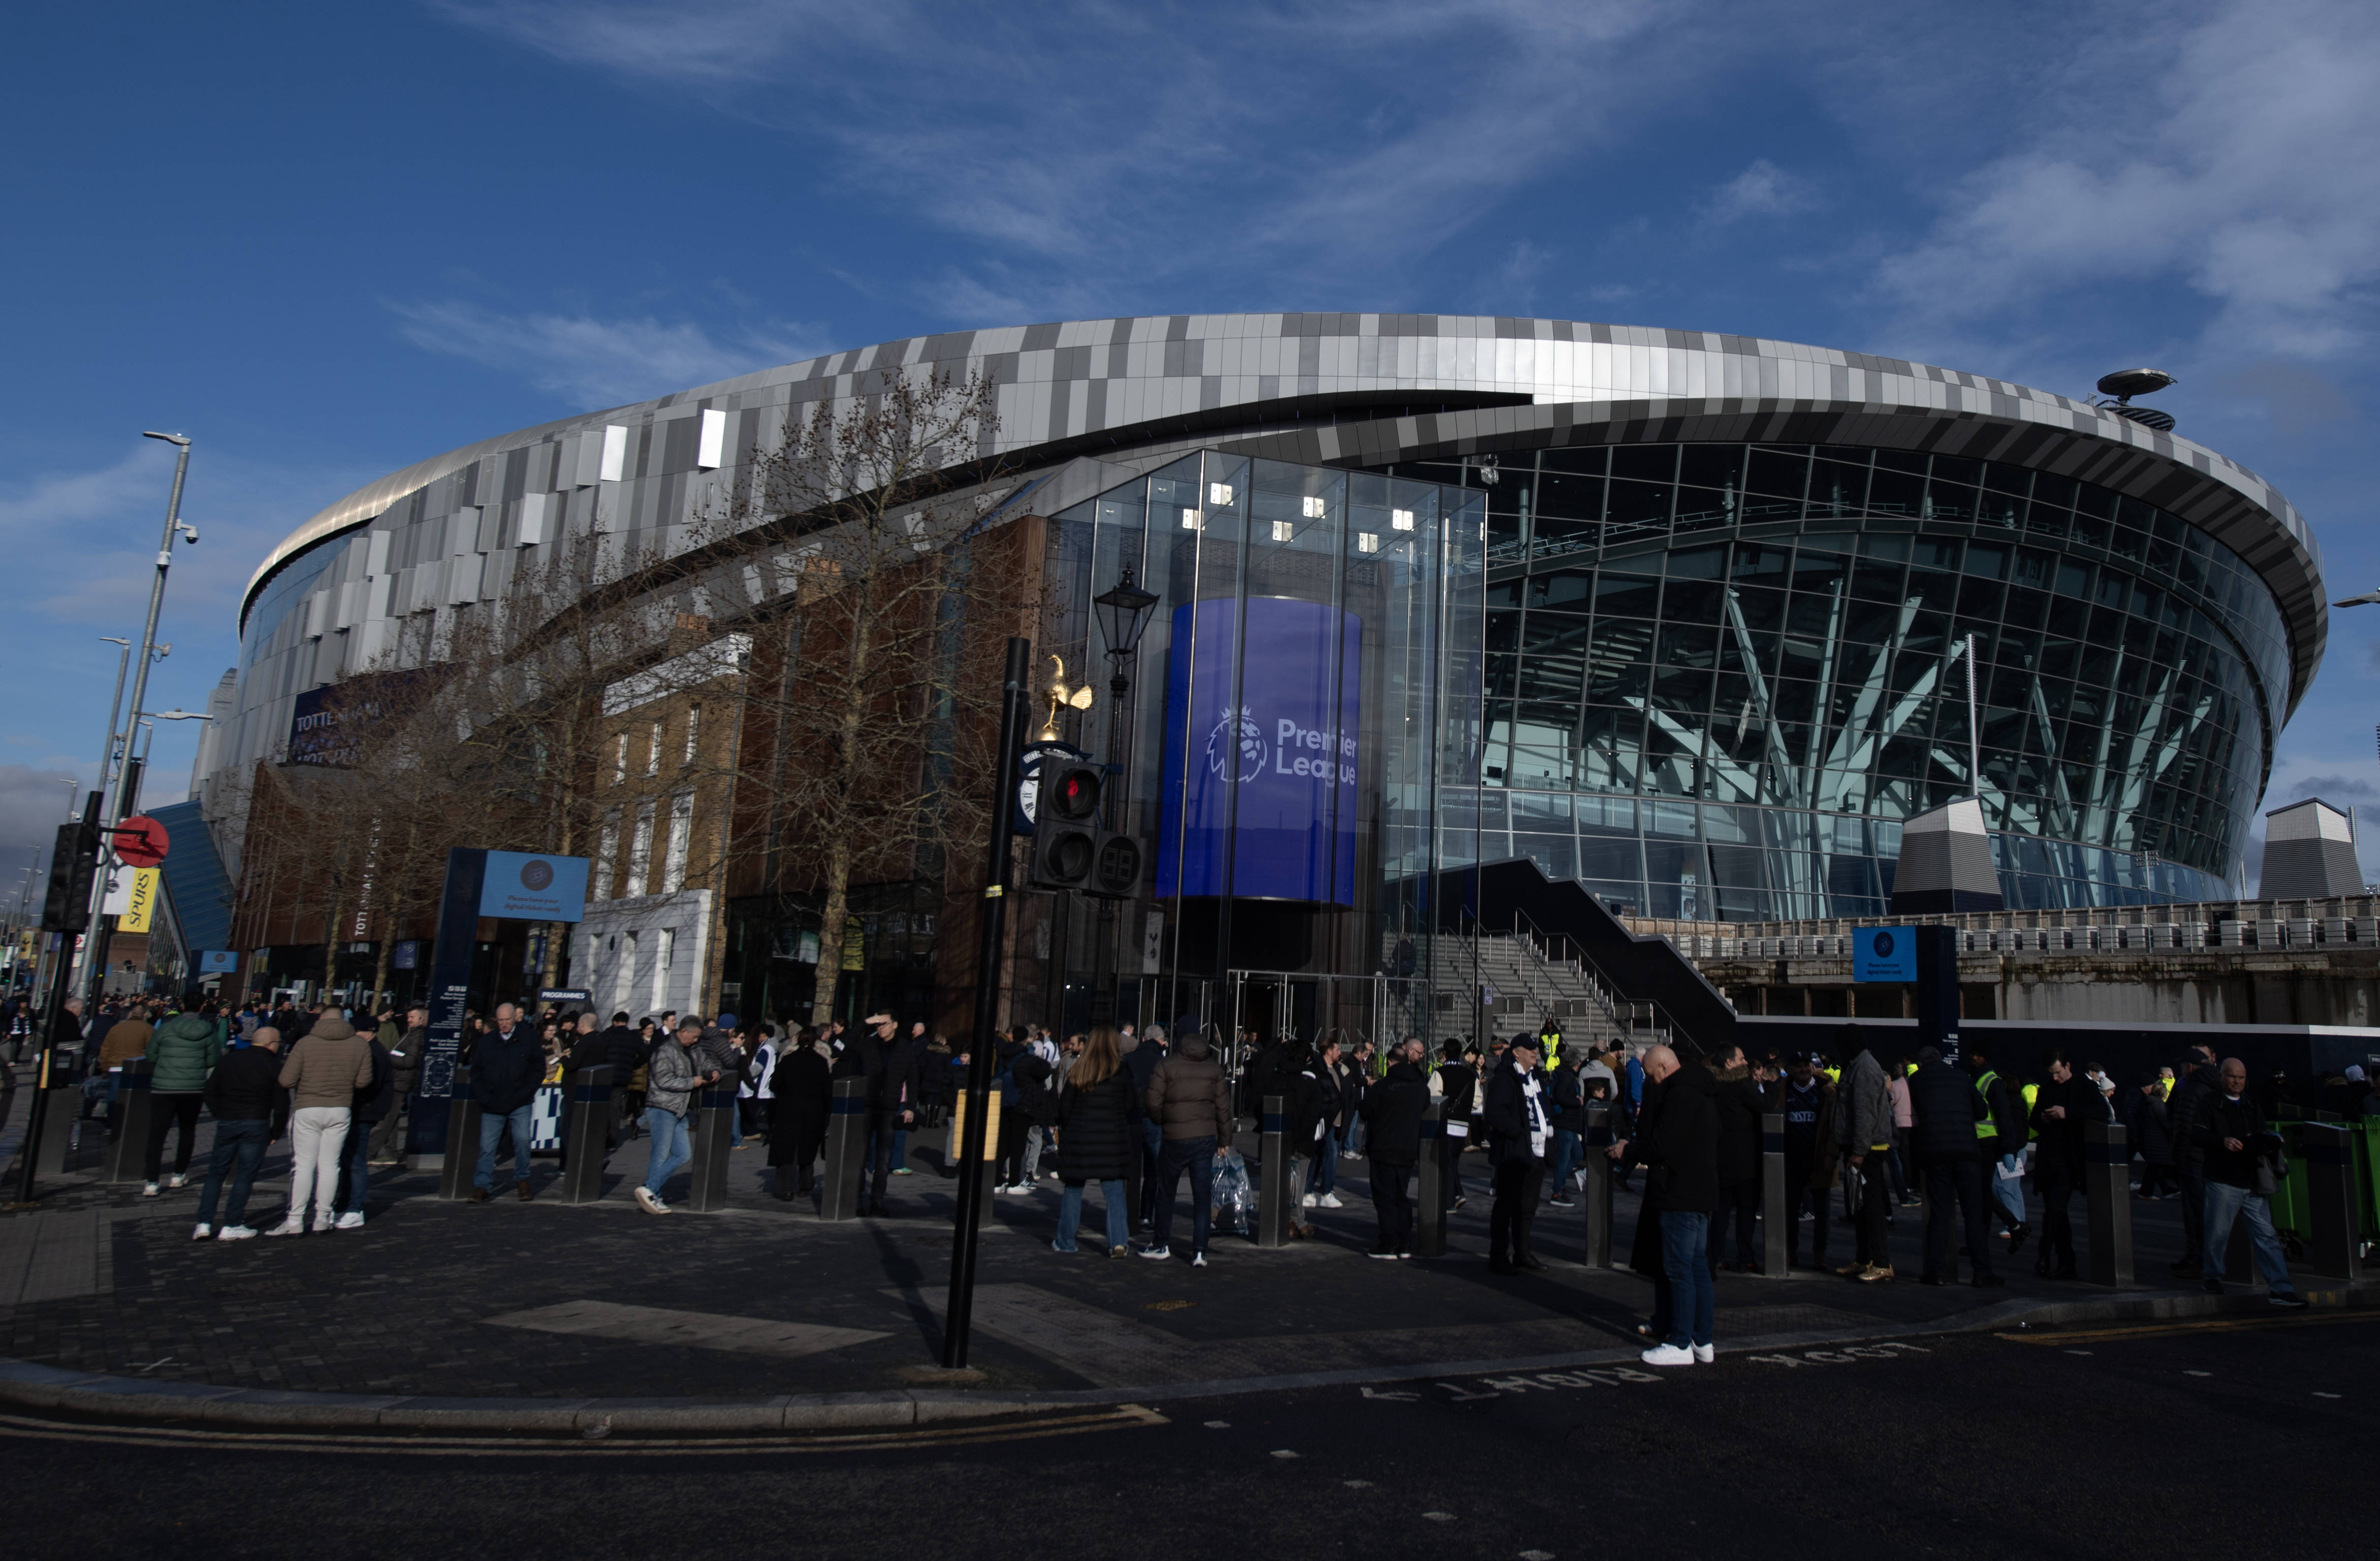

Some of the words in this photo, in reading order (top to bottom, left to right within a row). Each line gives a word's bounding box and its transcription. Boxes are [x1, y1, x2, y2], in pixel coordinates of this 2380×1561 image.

[1277, 718, 1356, 758] Premier
[1276, 747, 1355, 788] League
[130, 872, 149, 927] SPURS
[541, 991, 586, 1000] PROGRAMMES
[1436, 1367, 1665, 1401] RIGHT
